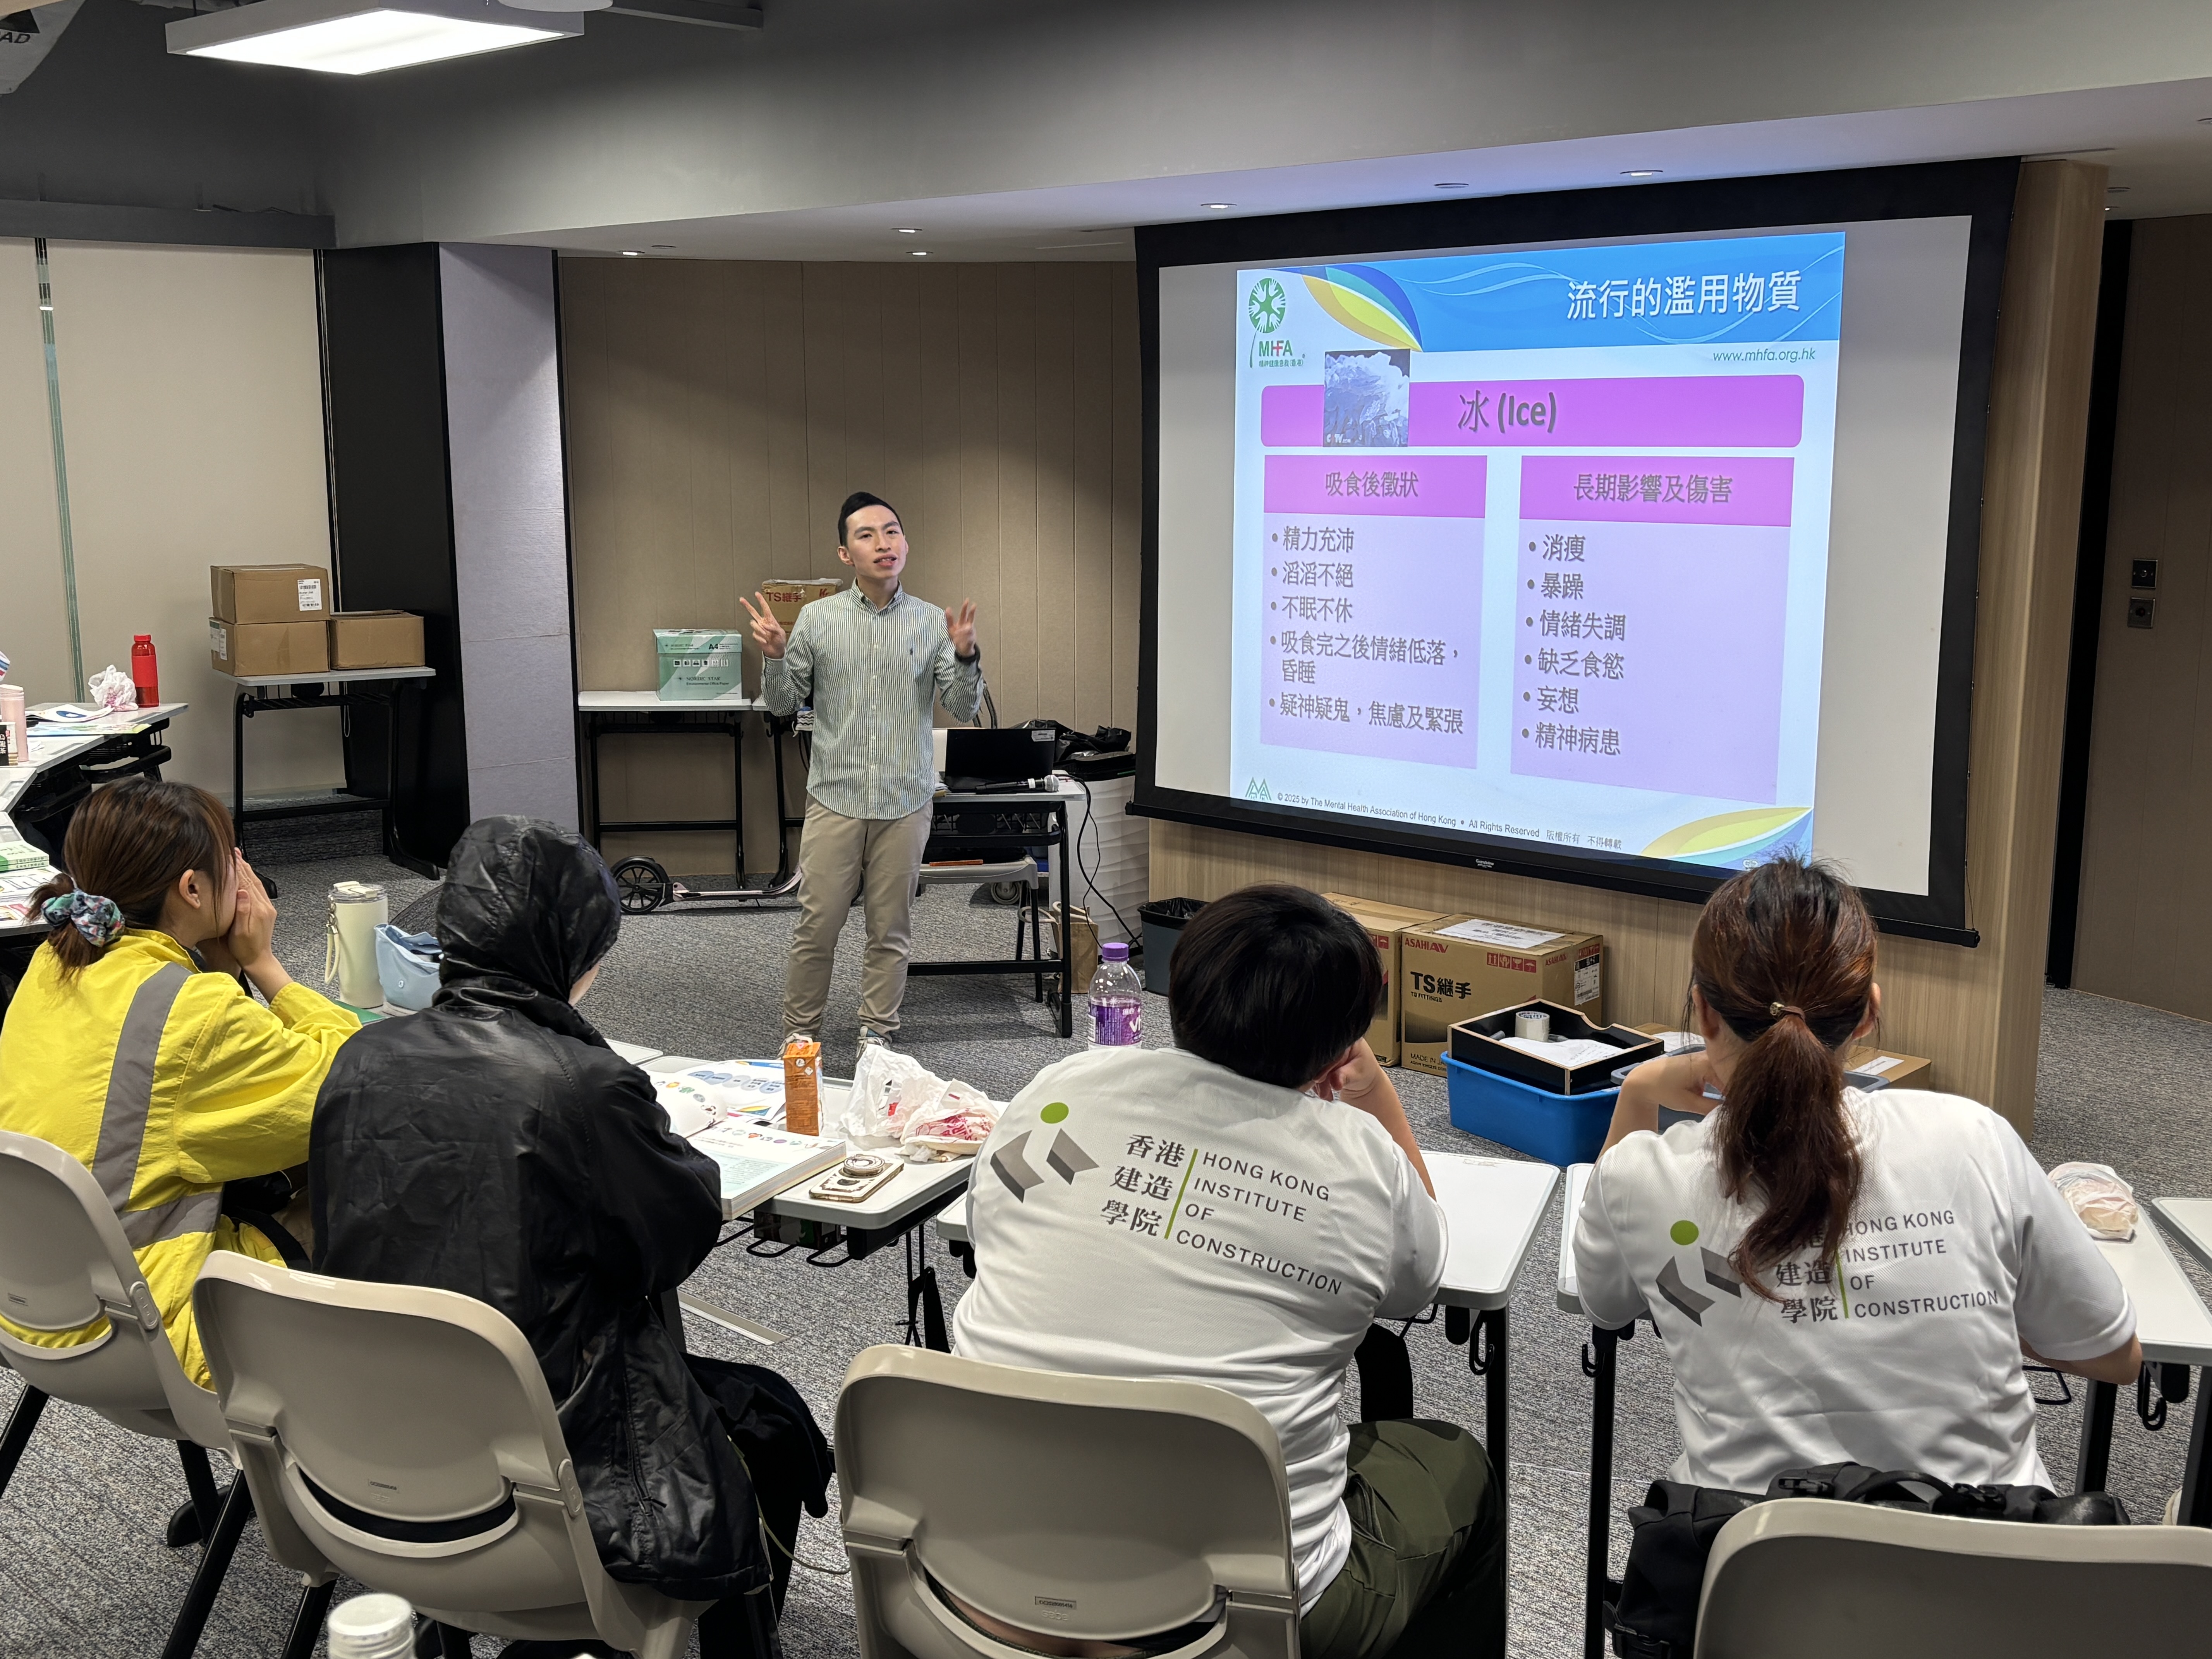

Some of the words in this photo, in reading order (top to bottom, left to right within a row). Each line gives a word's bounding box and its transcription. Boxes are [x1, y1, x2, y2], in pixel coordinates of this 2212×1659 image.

[0, 32, 31, 44] AD
[1567, 270, 1802, 320] 流行的濫用物質
[1259, 340, 1293, 357] MHFA
[1713, 349, 1815, 363] www.mhfa.org.hk
[1458, 390, 1489, 432] 冰
[1498, 392, 1556, 433] (Ice)
[1325, 471, 1419, 498] 吸食後徵狀
[1573, 473, 1733, 503] 長期影響及傷害
[1283, 526, 1354, 553] 精力充沛
[1542, 534, 1586, 562] 消瘦
[1282, 561, 1353, 588] 滔滔不絕
[1540, 572, 1584, 600] 暴躁
[1281, 596, 1353, 623] 不眠不休
[1540, 609, 1626, 641] 情緒失調
[1282, 659, 1316, 684] 昏睡
[1538, 647, 1625, 680] 缺乏食慾
[1537, 685, 1579, 714] 妄想
[1535, 721, 1621, 756] 精神病患
[1284, 793, 1300, 803] 2025
[1302, 796, 1309, 805] by
[1311, 797, 1322, 807] The
[1324, 799, 1346, 810] Mental
[1347, 802, 1368, 813] Health
[1370, 805, 1408, 819] Association
[1410, 811, 1416, 819] of
[1418, 812, 1436, 824] Hong
[1438, 815, 1456, 827] Kong
[1469, 819, 1478, 828] All
[1480, 821, 1503, 832] Rights
[1505, 824, 1540, 837] Reserved
[1410, 971, 1472, 999] TS継手
[1125, 1133, 1186, 1168] 香港
[1109, 1164, 1174, 1202] 建造
[1202, 1151, 1263, 1180] HONG
[1270, 1169, 1331, 1202] KONG
[1184, 1203, 1216, 1222] OF
[1193, 1176, 1307, 1222] INSTITUTE
[1099, 1199, 1163, 1237] 學院
[1903, 1209, 1955, 1228] KONG
[1176, 1229, 1342, 1296] CONSTRUCTION
[1844, 1239, 1947, 1264] INSTITUTE
[1776, 1259, 1832, 1288] 建造
[1850, 1274, 1875, 1291] OF
[1781, 1296, 1838, 1324] 學院
[1854, 1290, 1999, 1318] CONSTRUCTION
